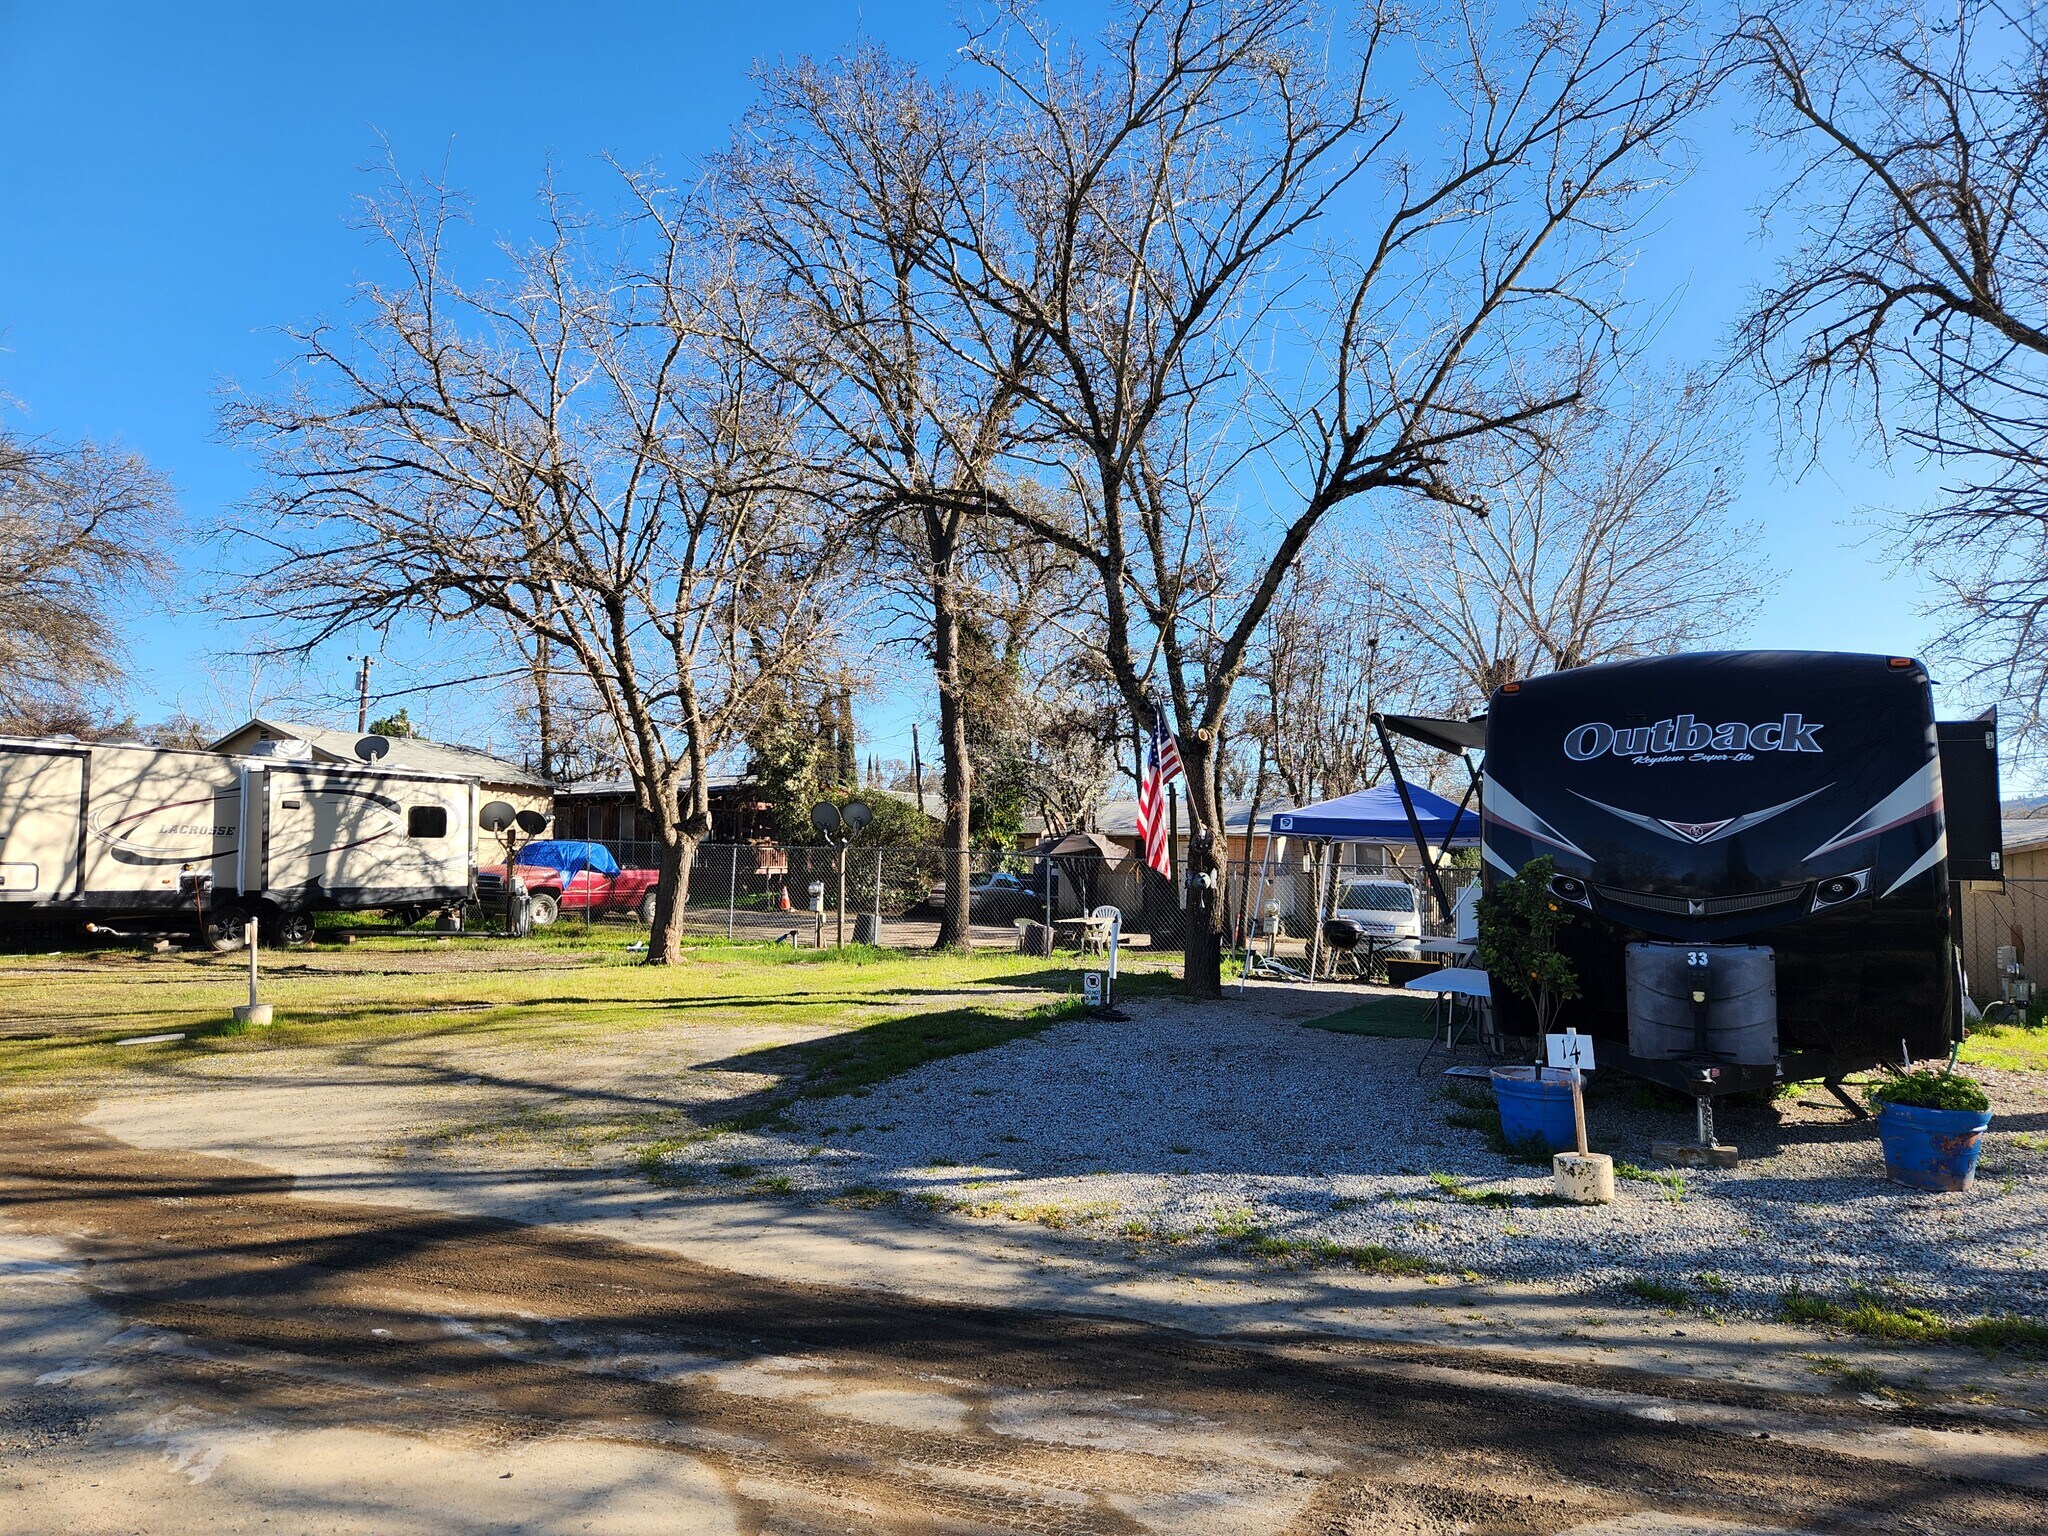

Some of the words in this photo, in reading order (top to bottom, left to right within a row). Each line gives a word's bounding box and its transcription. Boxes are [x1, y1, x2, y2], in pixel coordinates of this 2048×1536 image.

[1564, 713, 1824, 761] Outback
[1632, 755, 1685, 766] Keystone
[1688, 752, 1755, 763] Super-Lite
[159, 824, 236, 836] LACROSSE
[1687, 951, 1709, 966] 33
[1561, 1038, 1581, 1065] 14
